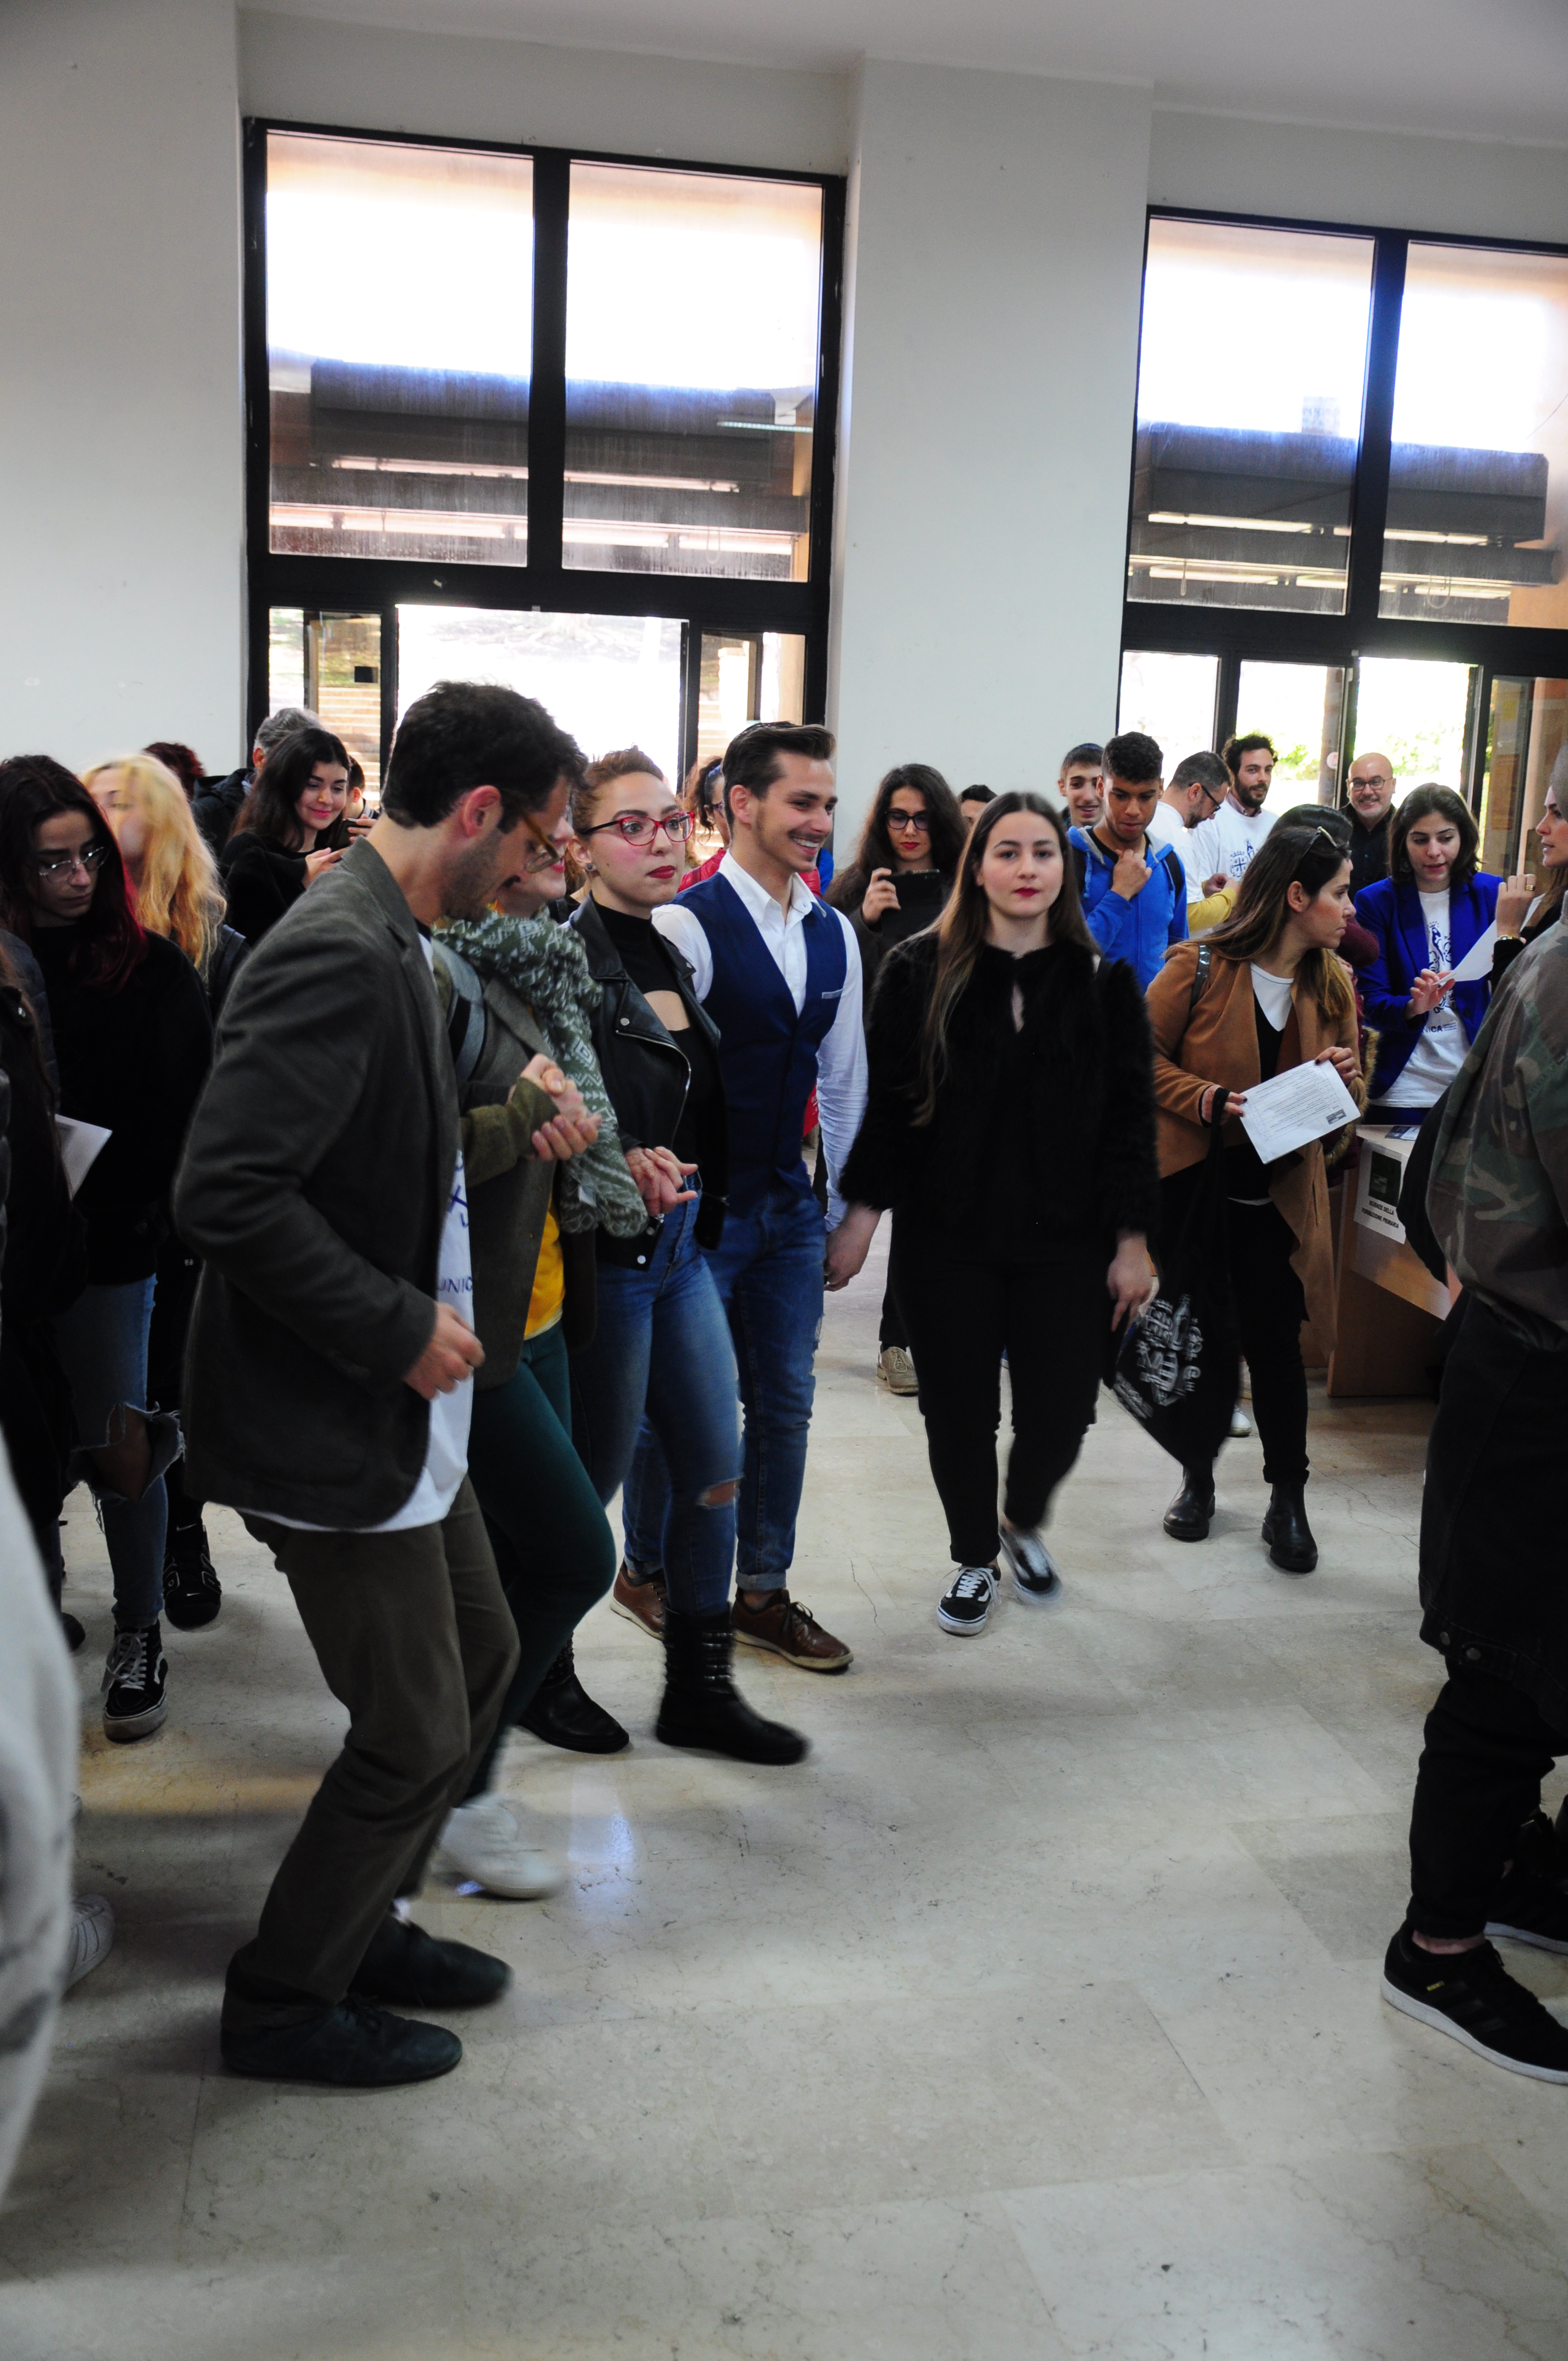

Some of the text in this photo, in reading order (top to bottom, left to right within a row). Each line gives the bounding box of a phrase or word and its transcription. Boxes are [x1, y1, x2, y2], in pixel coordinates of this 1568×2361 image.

[1369, 1200, 1394, 1215] SCIENZE DELLA
[1382, 1217, 1399, 1228] PRIMARIA
